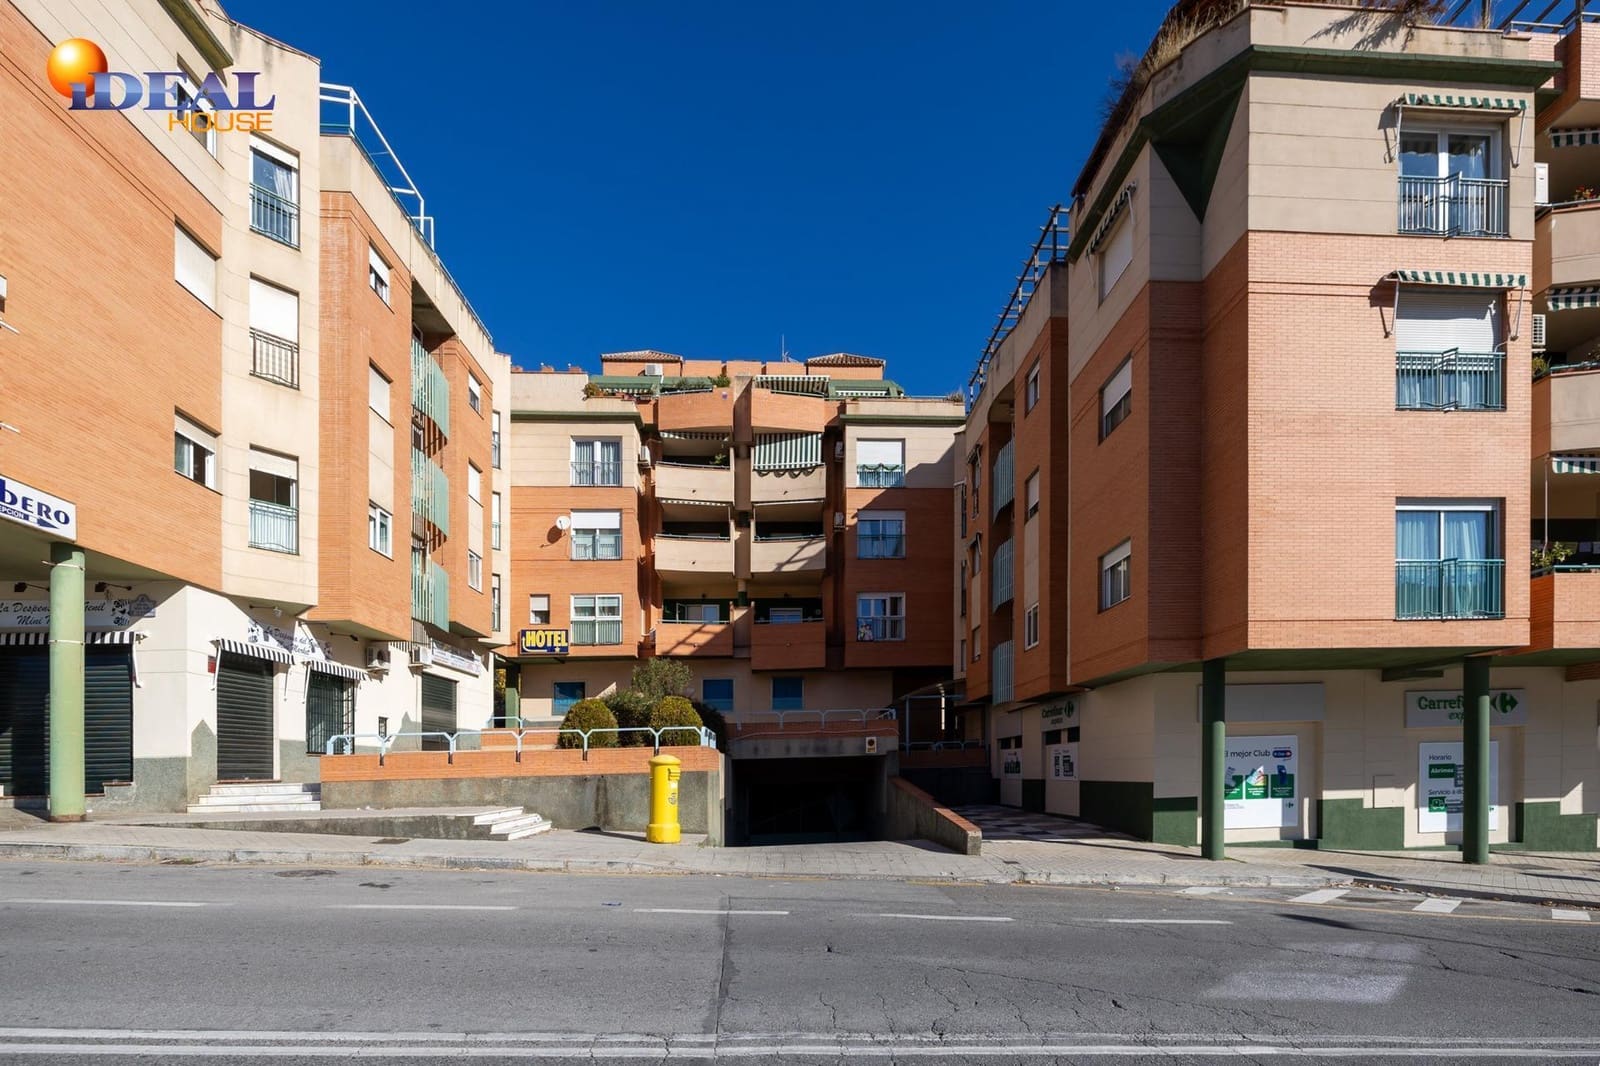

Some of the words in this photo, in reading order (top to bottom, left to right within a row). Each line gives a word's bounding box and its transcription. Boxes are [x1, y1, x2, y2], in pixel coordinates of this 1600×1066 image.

[12, 602, 50, 614] Despen
[17, 615, 42, 625] Mini
[525, 630, 568, 648] HOTEL
[1418, 695, 1464, 710] Carref
[1230, 750, 1252, 759] mejor
[1253, 749, 1271, 757] Club
[1428, 788, 1451, 796] Servicio
